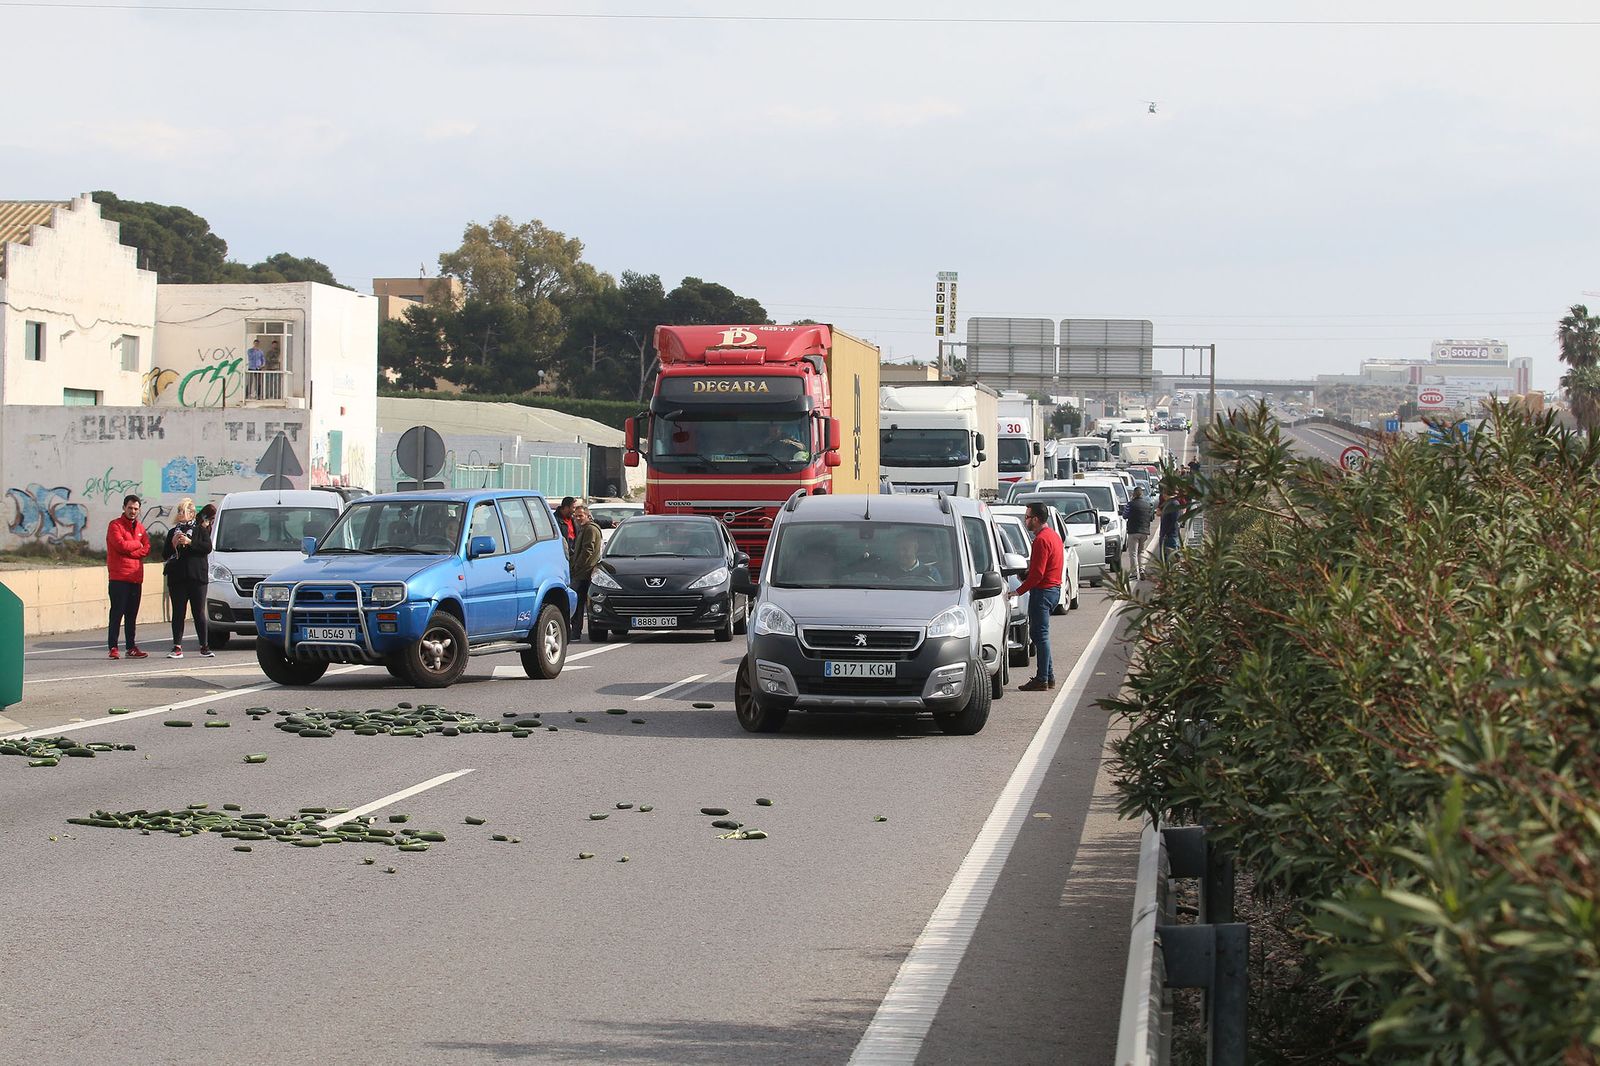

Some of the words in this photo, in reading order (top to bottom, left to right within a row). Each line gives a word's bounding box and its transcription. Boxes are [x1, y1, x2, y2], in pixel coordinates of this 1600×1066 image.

[936, 282, 945, 336] HOTEL
[197, 346, 236, 361] VOX
[1451, 347, 1488, 358] sotrafa
[693, 380, 769, 394] DEGARA
[1007, 424, 1021, 433] 30
[637, 618, 657, 626] 8889
[661, 617, 676, 626] GYC
[308, 629, 320, 639] AL
[322, 629, 344, 639] 0549
[347, 629, 353, 639] Y
[833, 663, 864, 676] 8171
[869, 664, 893, 676] KGM
